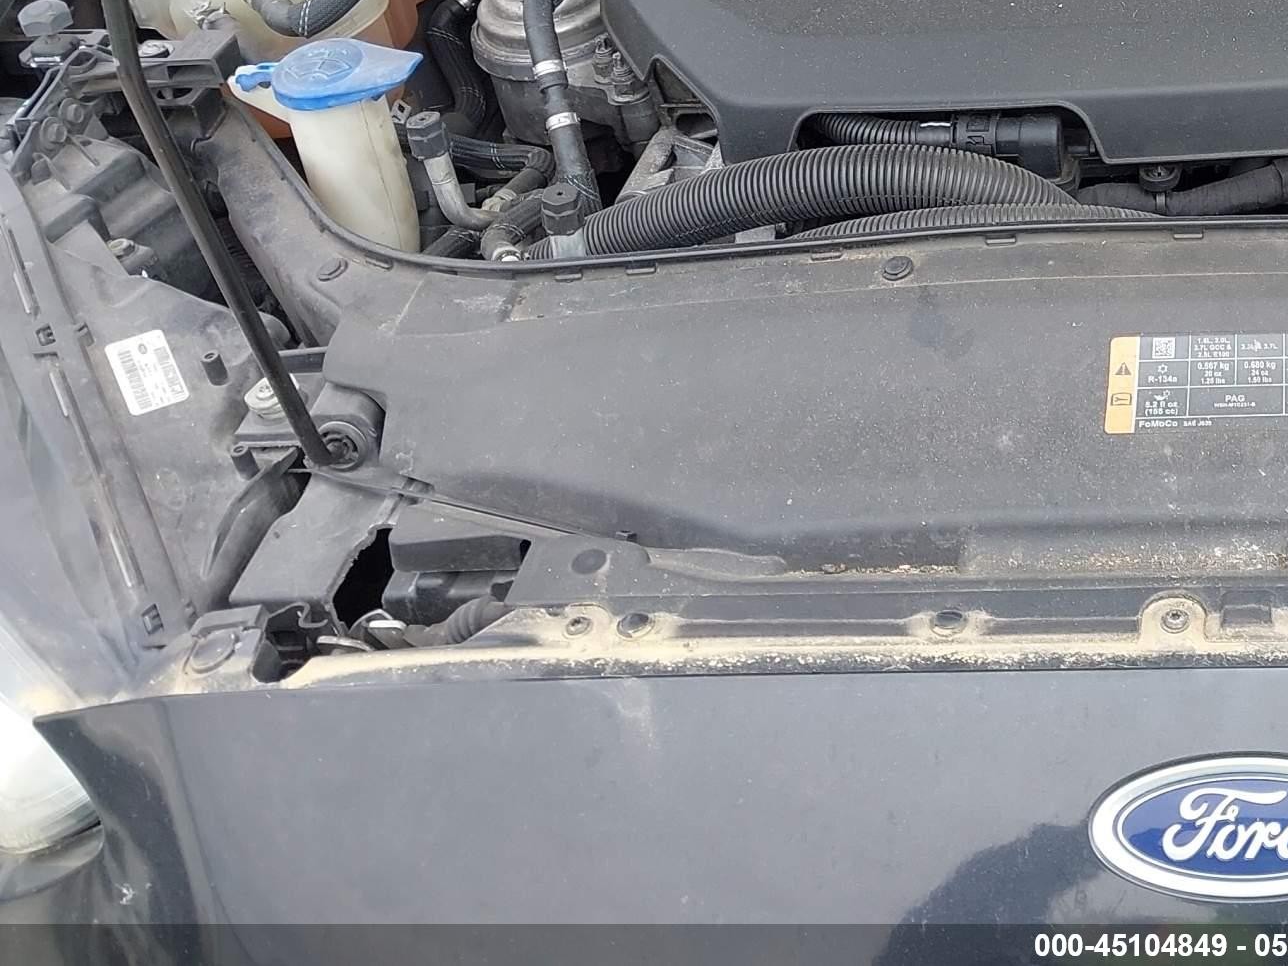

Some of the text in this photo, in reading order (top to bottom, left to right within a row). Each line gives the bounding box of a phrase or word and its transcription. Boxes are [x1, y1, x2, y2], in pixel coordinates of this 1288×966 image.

[1219, 361, 1229, 371] kg
[1266, 361, 1276, 370] kg
[1148, 375, 1177, 383] R-134a
